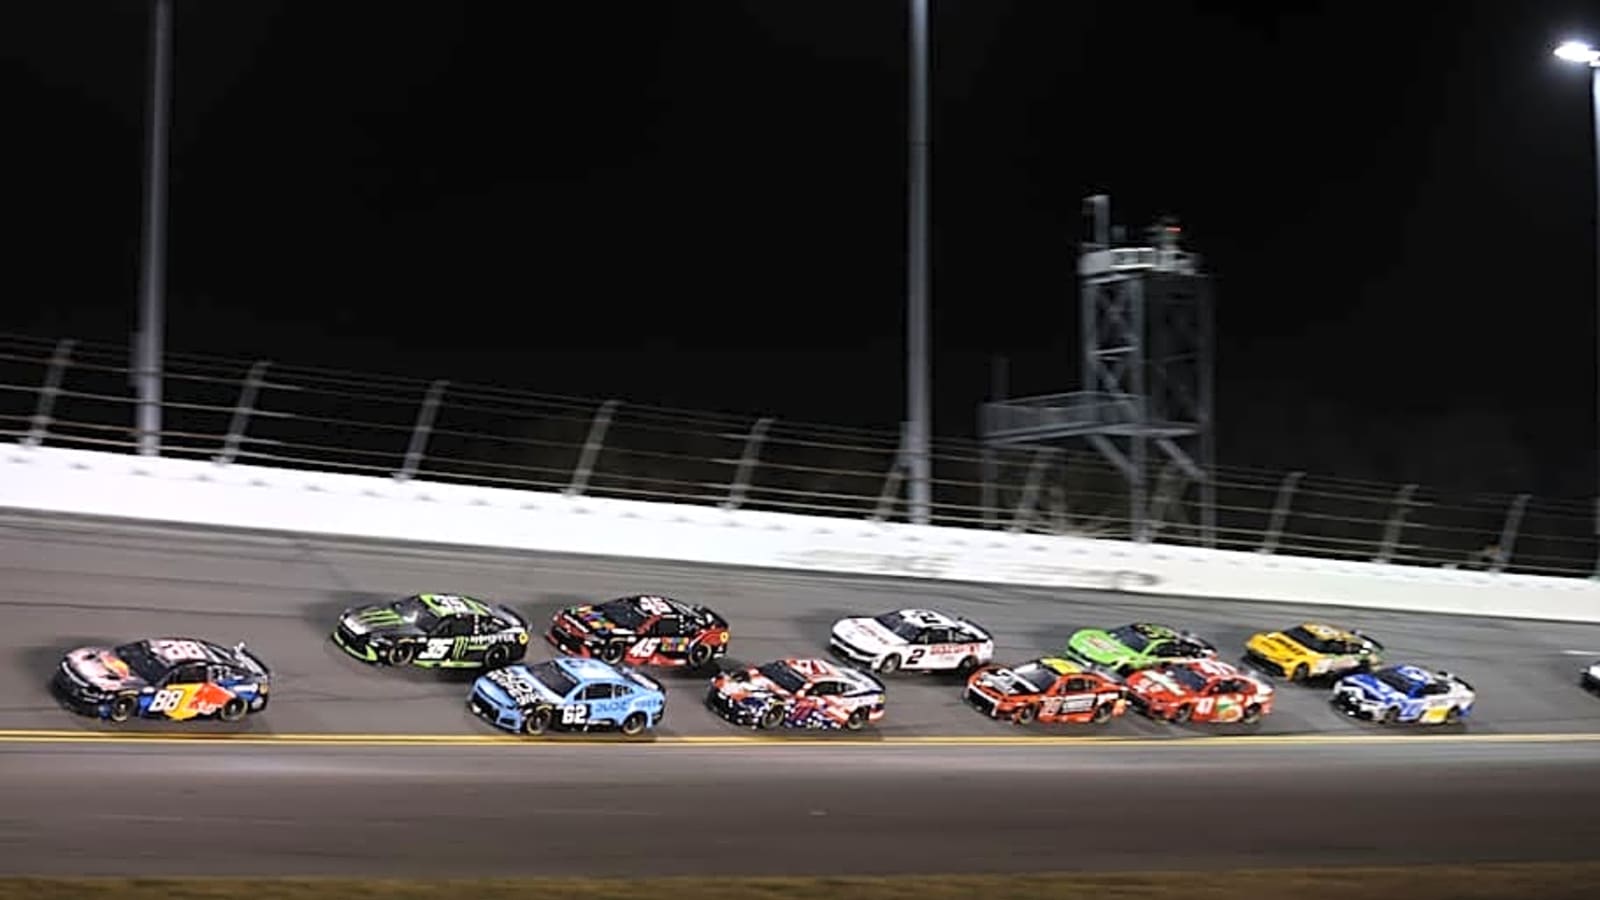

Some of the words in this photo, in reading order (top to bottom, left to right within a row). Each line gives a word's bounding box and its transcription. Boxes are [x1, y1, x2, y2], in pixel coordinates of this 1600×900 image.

[630, 637, 660, 658] 45
[906, 649, 926, 665] 2
[149, 690, 184, 712] 88
[561, 705, 588, 724] 62
